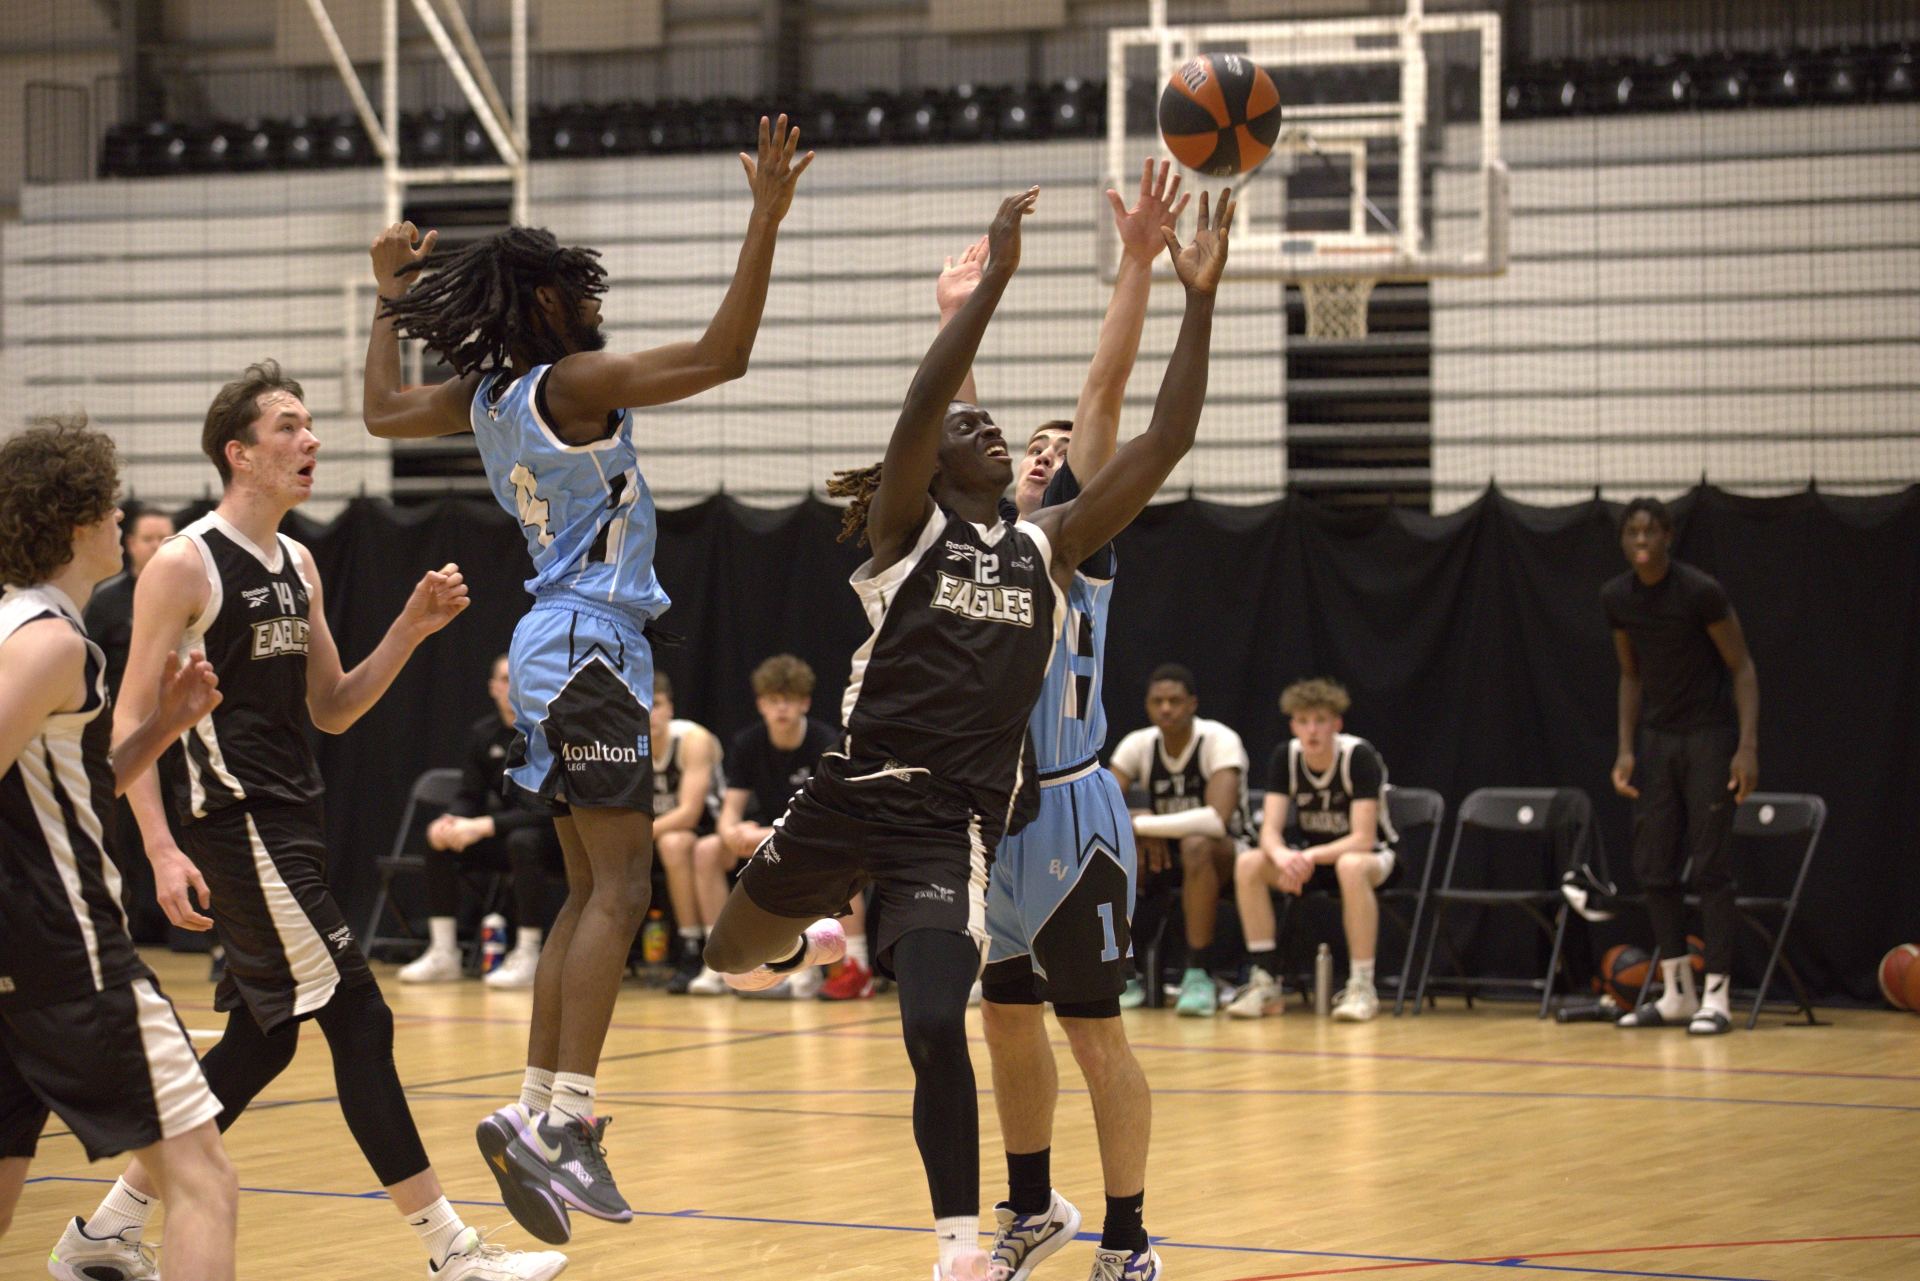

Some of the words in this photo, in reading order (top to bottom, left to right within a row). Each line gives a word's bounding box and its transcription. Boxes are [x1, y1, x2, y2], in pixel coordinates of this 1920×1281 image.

[945, 540, 976, 552] Reebo
[974, 548, 1000, 585] 12
[241, 586, 270, 599] Reebok
[271, 581, 297, 615] 14
[930, 571, 1034, 628] EAGLES
[251, 617, 310, 660] EAGLE
[566, 762, 587, 772] LEGE
[1097, 902, 1134, 962] 1
